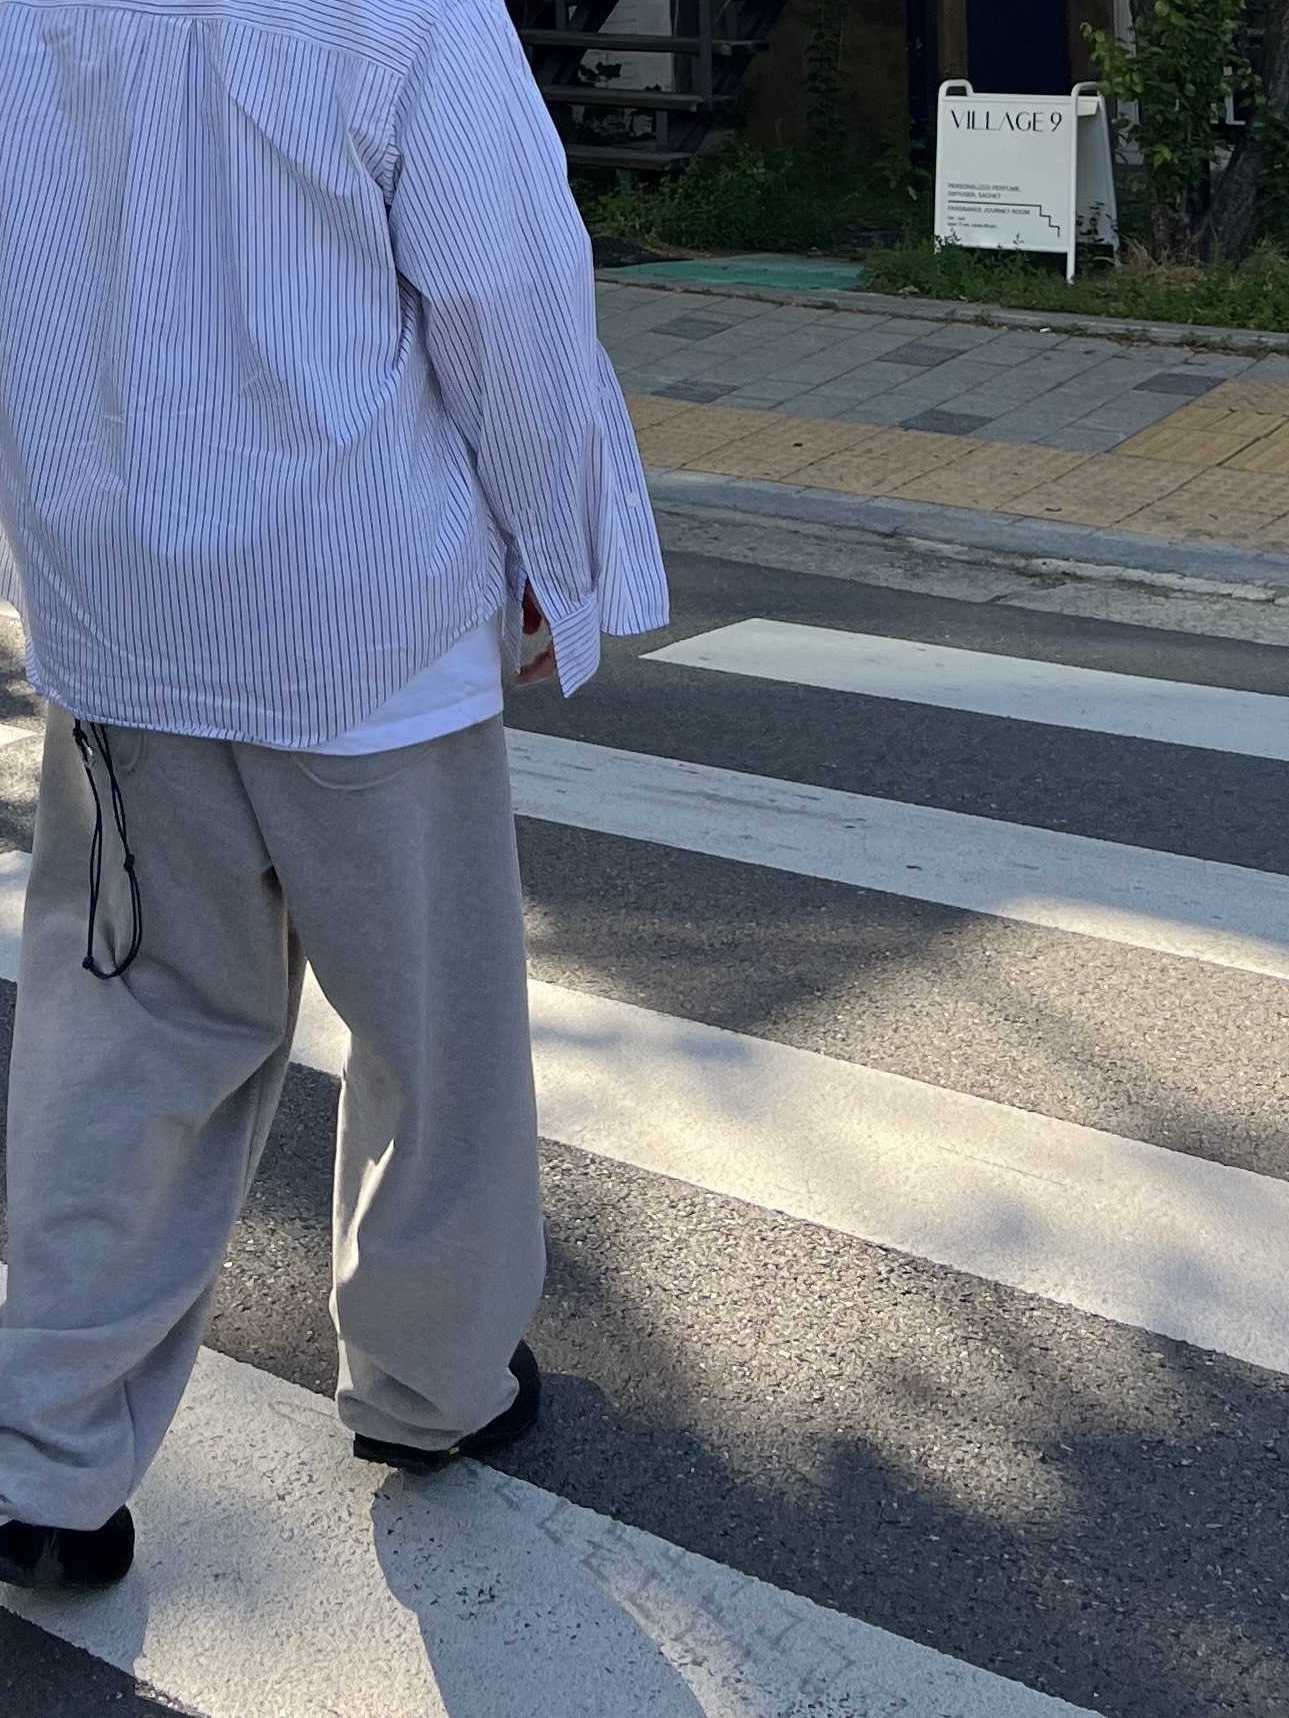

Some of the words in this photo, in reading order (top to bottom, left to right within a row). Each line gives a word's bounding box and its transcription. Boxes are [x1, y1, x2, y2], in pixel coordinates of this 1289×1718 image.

[950, 109, 1044, 132] VILLAGE
[1050, 111, 1063, 133] 9
[948, 183, 991, 191] PERSONALIZED
[983, 207, 1010, 215] JOURNEY
